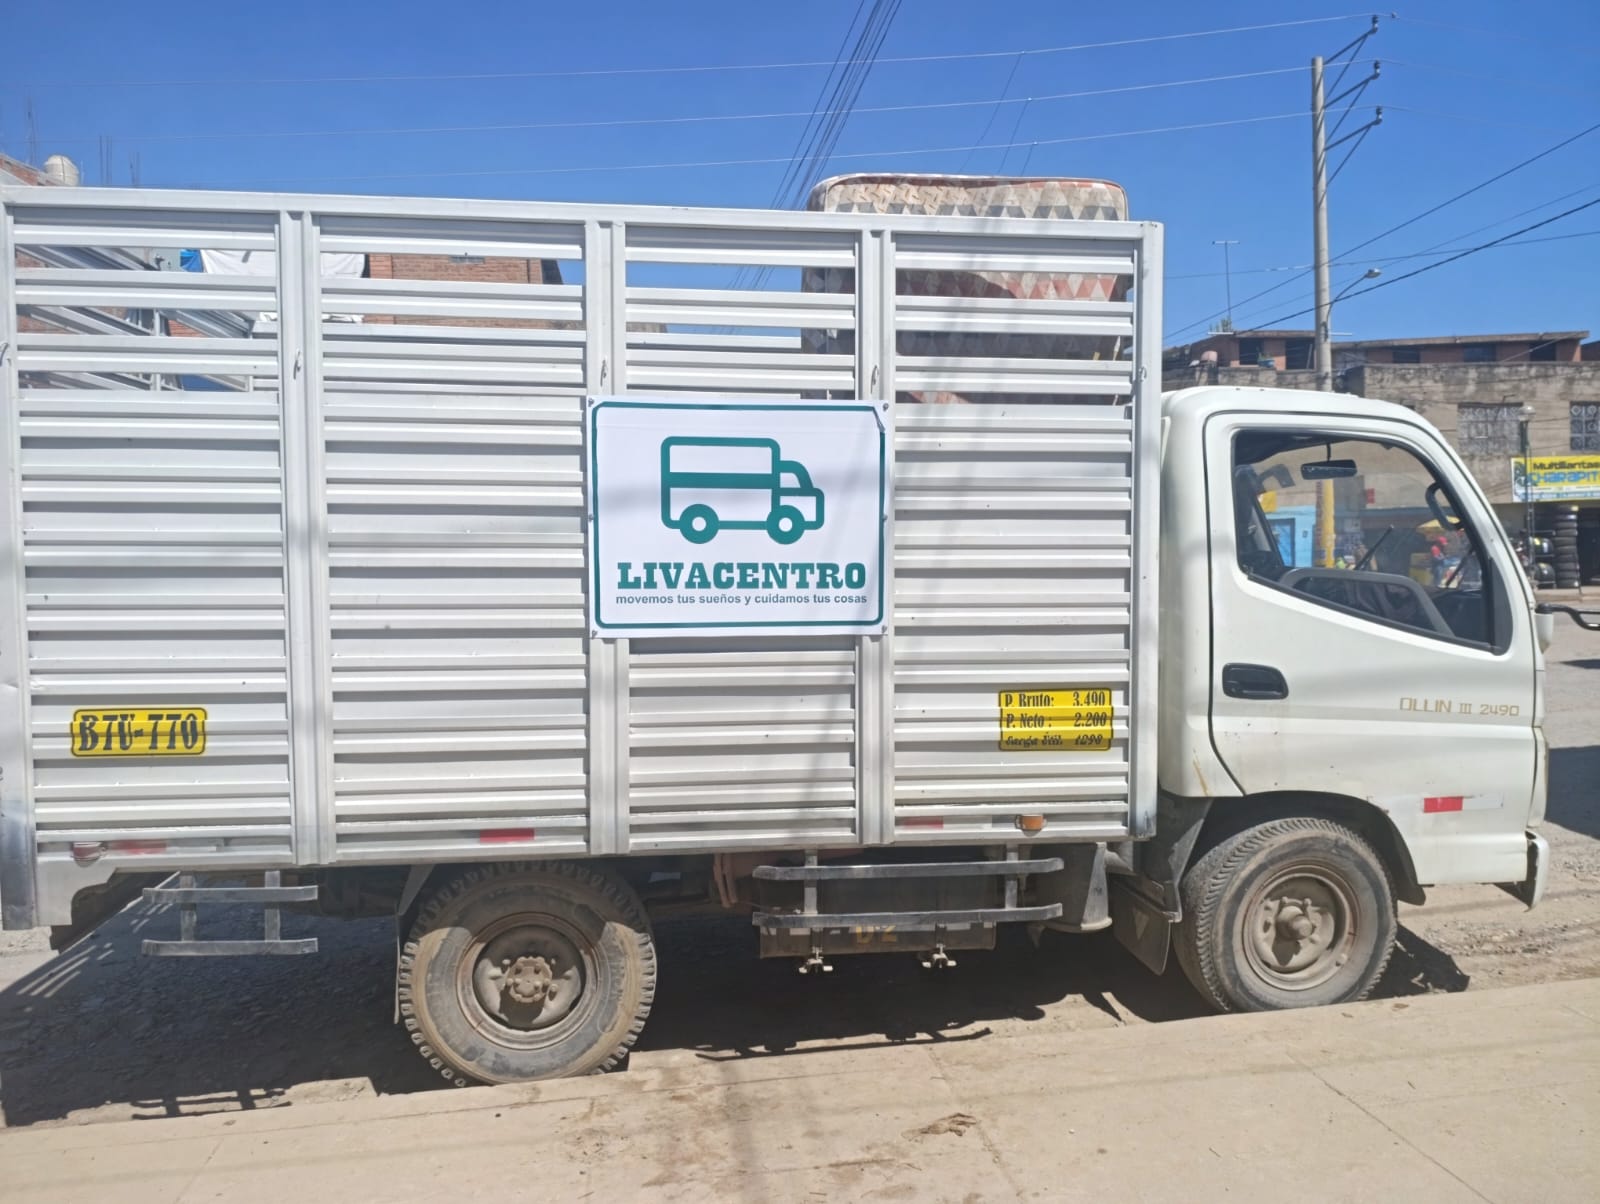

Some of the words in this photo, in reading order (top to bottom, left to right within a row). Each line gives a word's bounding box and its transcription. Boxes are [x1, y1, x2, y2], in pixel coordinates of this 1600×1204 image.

[617, 562, 866, 589] LIVACENTRO
[615, 595, 674, 604] movemos
[677, 594, 696, 604] tus
[699, 593, 741, 604] sueños
[744, 595, 751, 606] y
[754, 593, 810, 604] cuidamos
[813, 594, 831, 604] tus
[834, 595, 868, 604] cosas
[1018, 692, 1055, 707] Bruto:
[1072, 691, 1106, 707] 3.490
[1399, 697, 1453, 713] OLLIN
[1458, 702, 1473, 715] III
[1479, 704, 1520, 717] 2490
[1006, 713, 1016, 728] P.
[1073, 712, 1107, 728] 2.200
